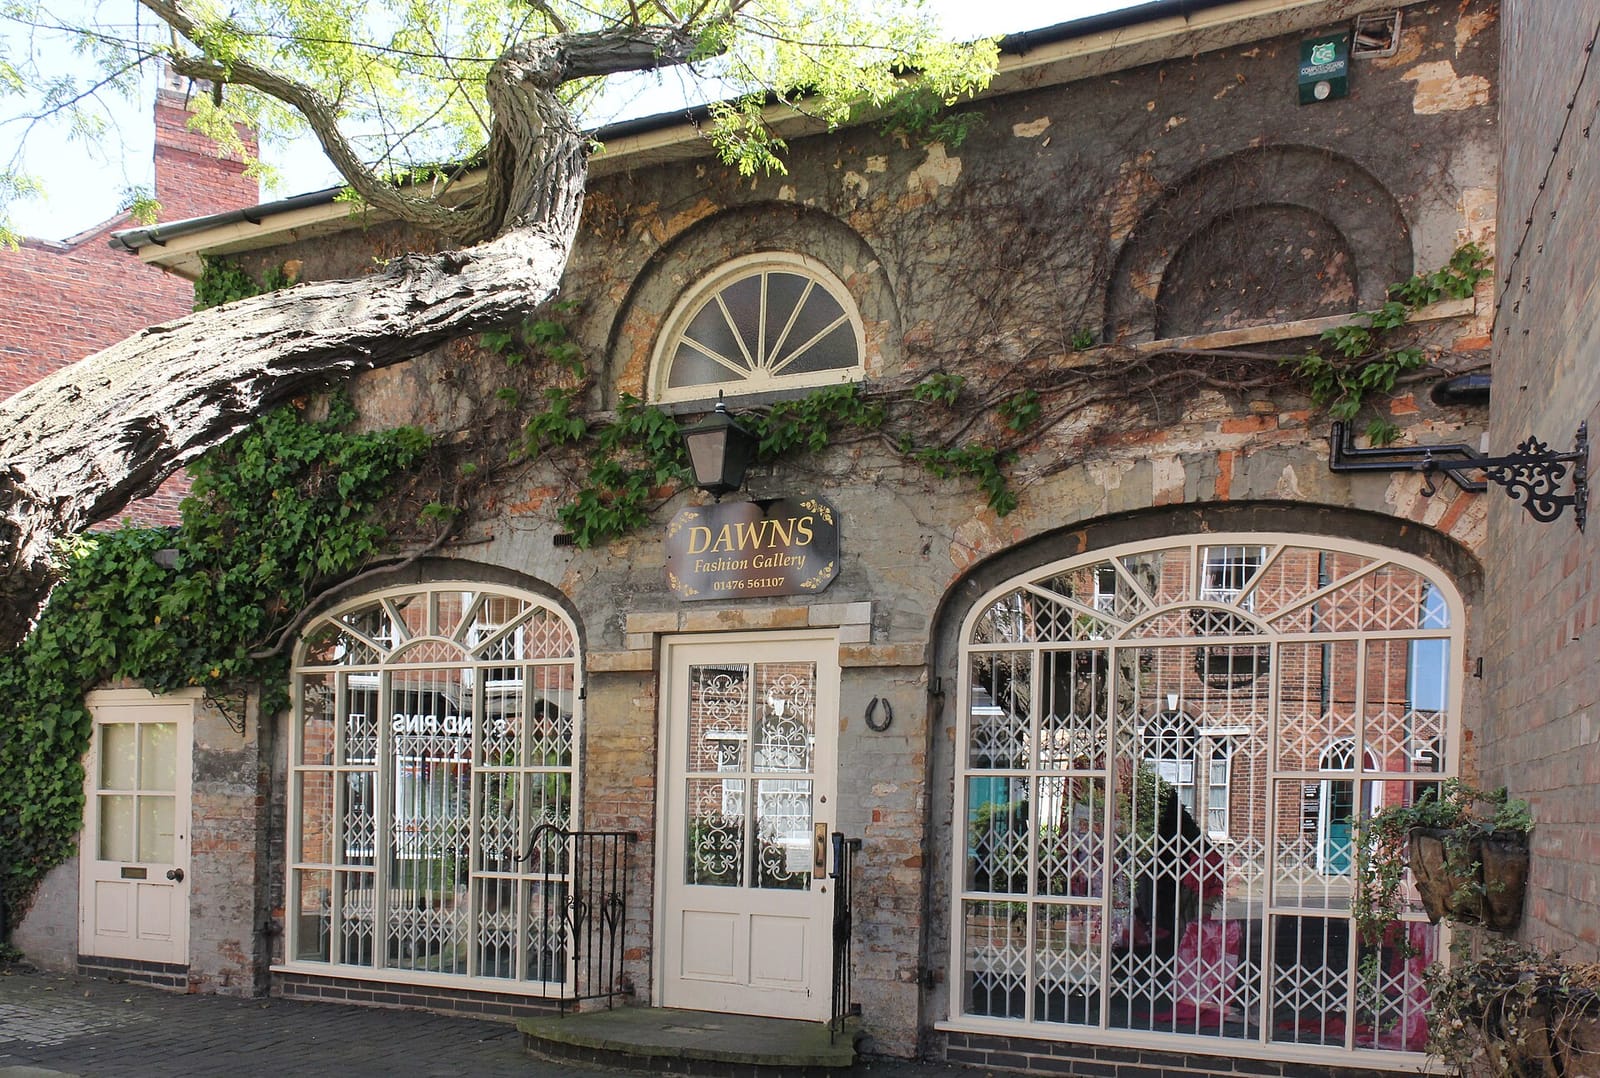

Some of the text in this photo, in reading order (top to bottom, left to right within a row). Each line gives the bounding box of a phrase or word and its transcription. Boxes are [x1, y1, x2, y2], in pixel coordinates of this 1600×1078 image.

[687, 516, 814, 554] DAWNS
[694, 552, 806, 573] Fashion Gallery
[713, 577, 785, 591] 01476 561107
